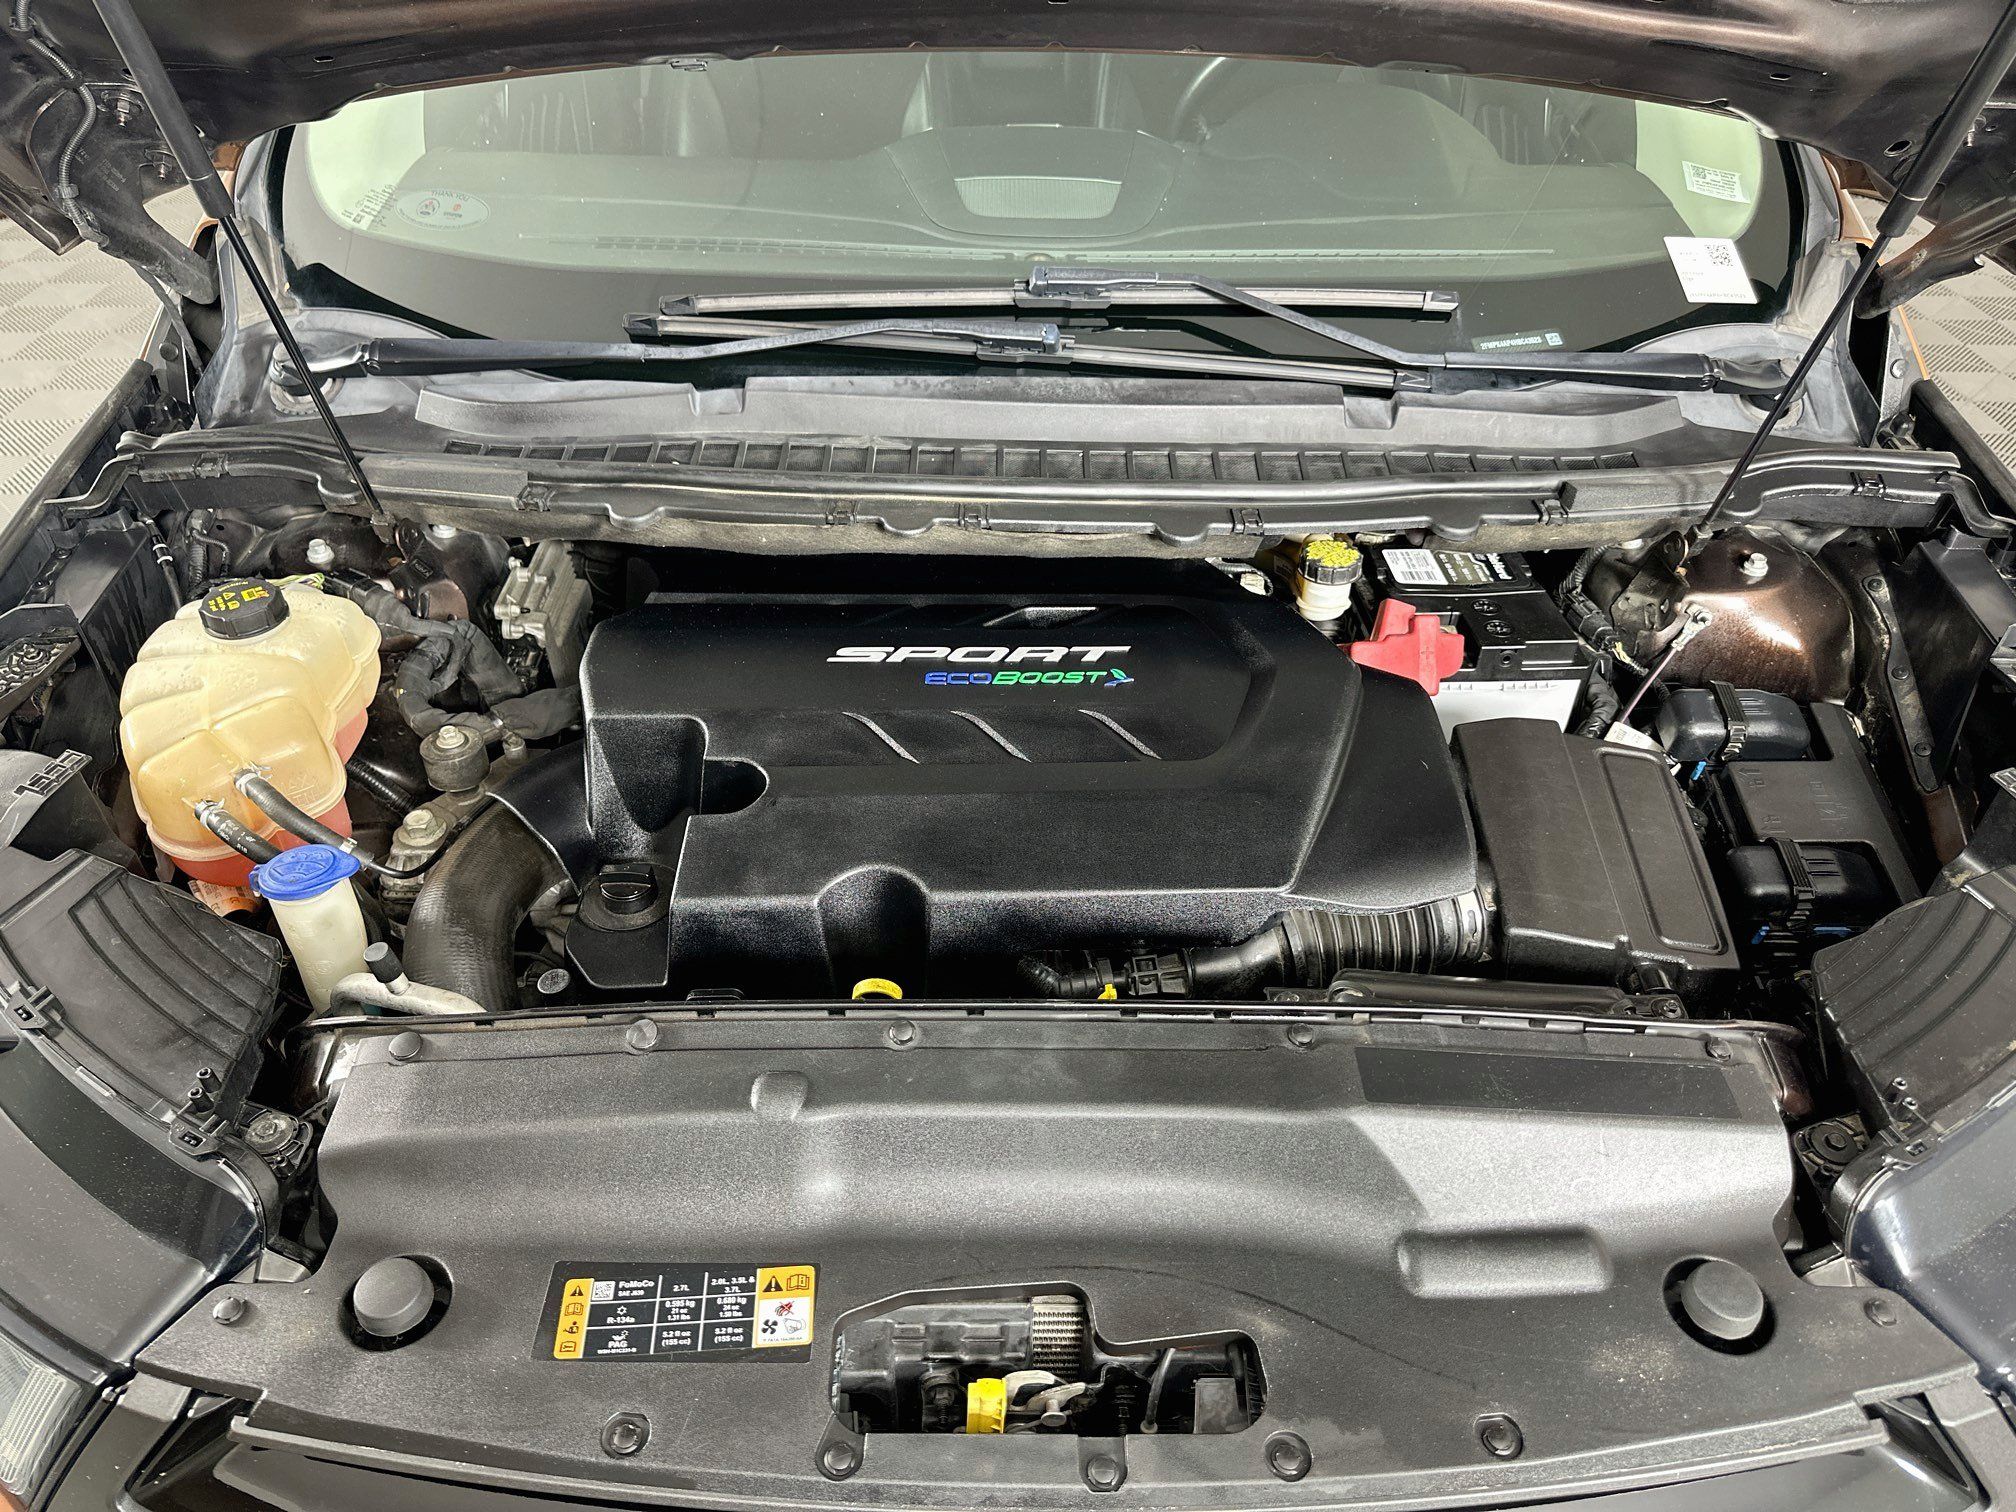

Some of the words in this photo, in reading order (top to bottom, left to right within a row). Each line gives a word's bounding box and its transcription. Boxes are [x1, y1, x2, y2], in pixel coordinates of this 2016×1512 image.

[430, 190, 455, 198] THANK
[455, 192, 470, 202] YOU
[826, 646, 1131, 663] SPORT
[924, 671, 1108, 686] ECOBOOST
[618, 1280, 655, 1289] FoMoCo
[672, 1284, 690, 1292] 2.7L
[724, 1286, 742, 1294] 3.7L
[685, 1299, 696, 1308] kg
[736, 1296, 748, 1305] kg
[606, 1316, 636, 1324] R-134a
[714, 1327, 727, 1335] 5.2
[661, 1338, 677, 1347] (155
[714, 1335, 731, 1343] (155
[607, 1340, 628, 1349] PAG
